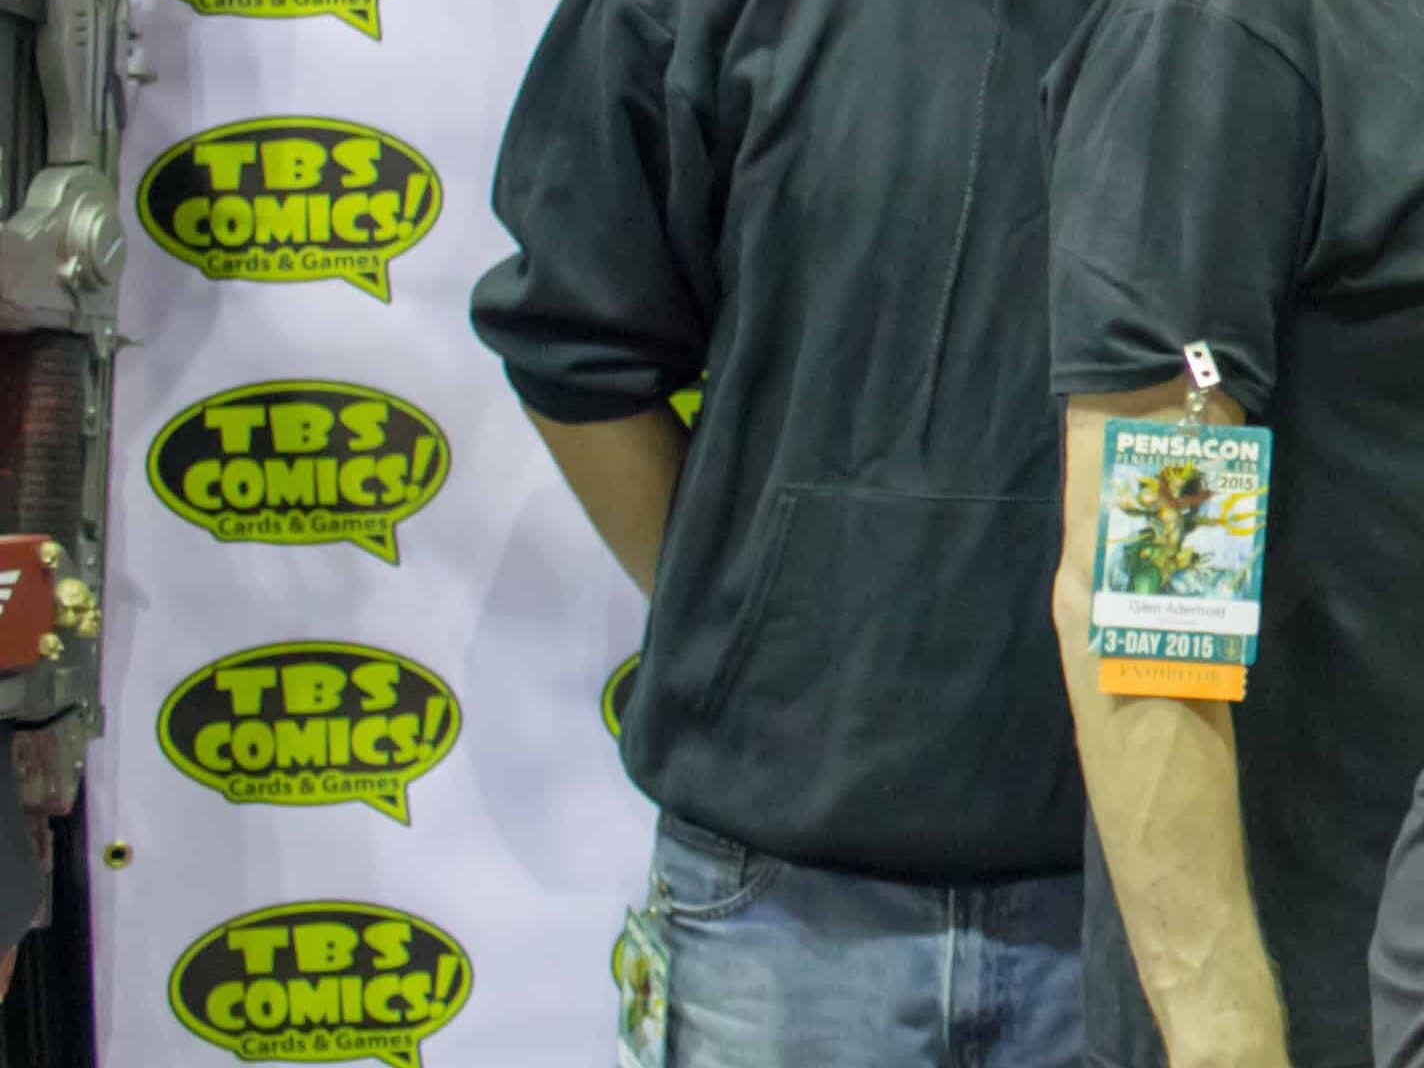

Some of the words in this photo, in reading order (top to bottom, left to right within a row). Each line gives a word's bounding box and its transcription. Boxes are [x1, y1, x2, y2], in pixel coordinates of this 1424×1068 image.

[193, 136, 382, 190] TBS
[172, 172, 430, 248] COMICS!
[206, 252, 271, 274] Cards
[278, 251, 295, 271] &
[301, 251, 381, 271] Games
[203, 399, 390, 453] TBS
[1117, 432, 1260, 461] PENSACON
[182, 435, 437, 511] COMICS!
[1220, 474, 1255, 490] 2015
[216, 515, 280, 537] Cards
[287, 514, 304, 534] &
[310, 514, 389, 534] Games
[1104, 629, 1161, 656] 3-DAY
[1165, 634, 1214, 659] 2015
[214, 660, 401, 715] TBS
[193, 695, 448, 773] COMICS!
[227, 776, 292, 799] Cards
[298, 775, 315, 795] &
[321, 775, 400, 795] Games
[226, 919, 413, 975] TBS
[205, 953, 460, 1032] COMICS!
[239, 1034, 304, 1057] Cards
[310, 1033, 328, 1052] &
[334, 1032, 412, 1052] Games
